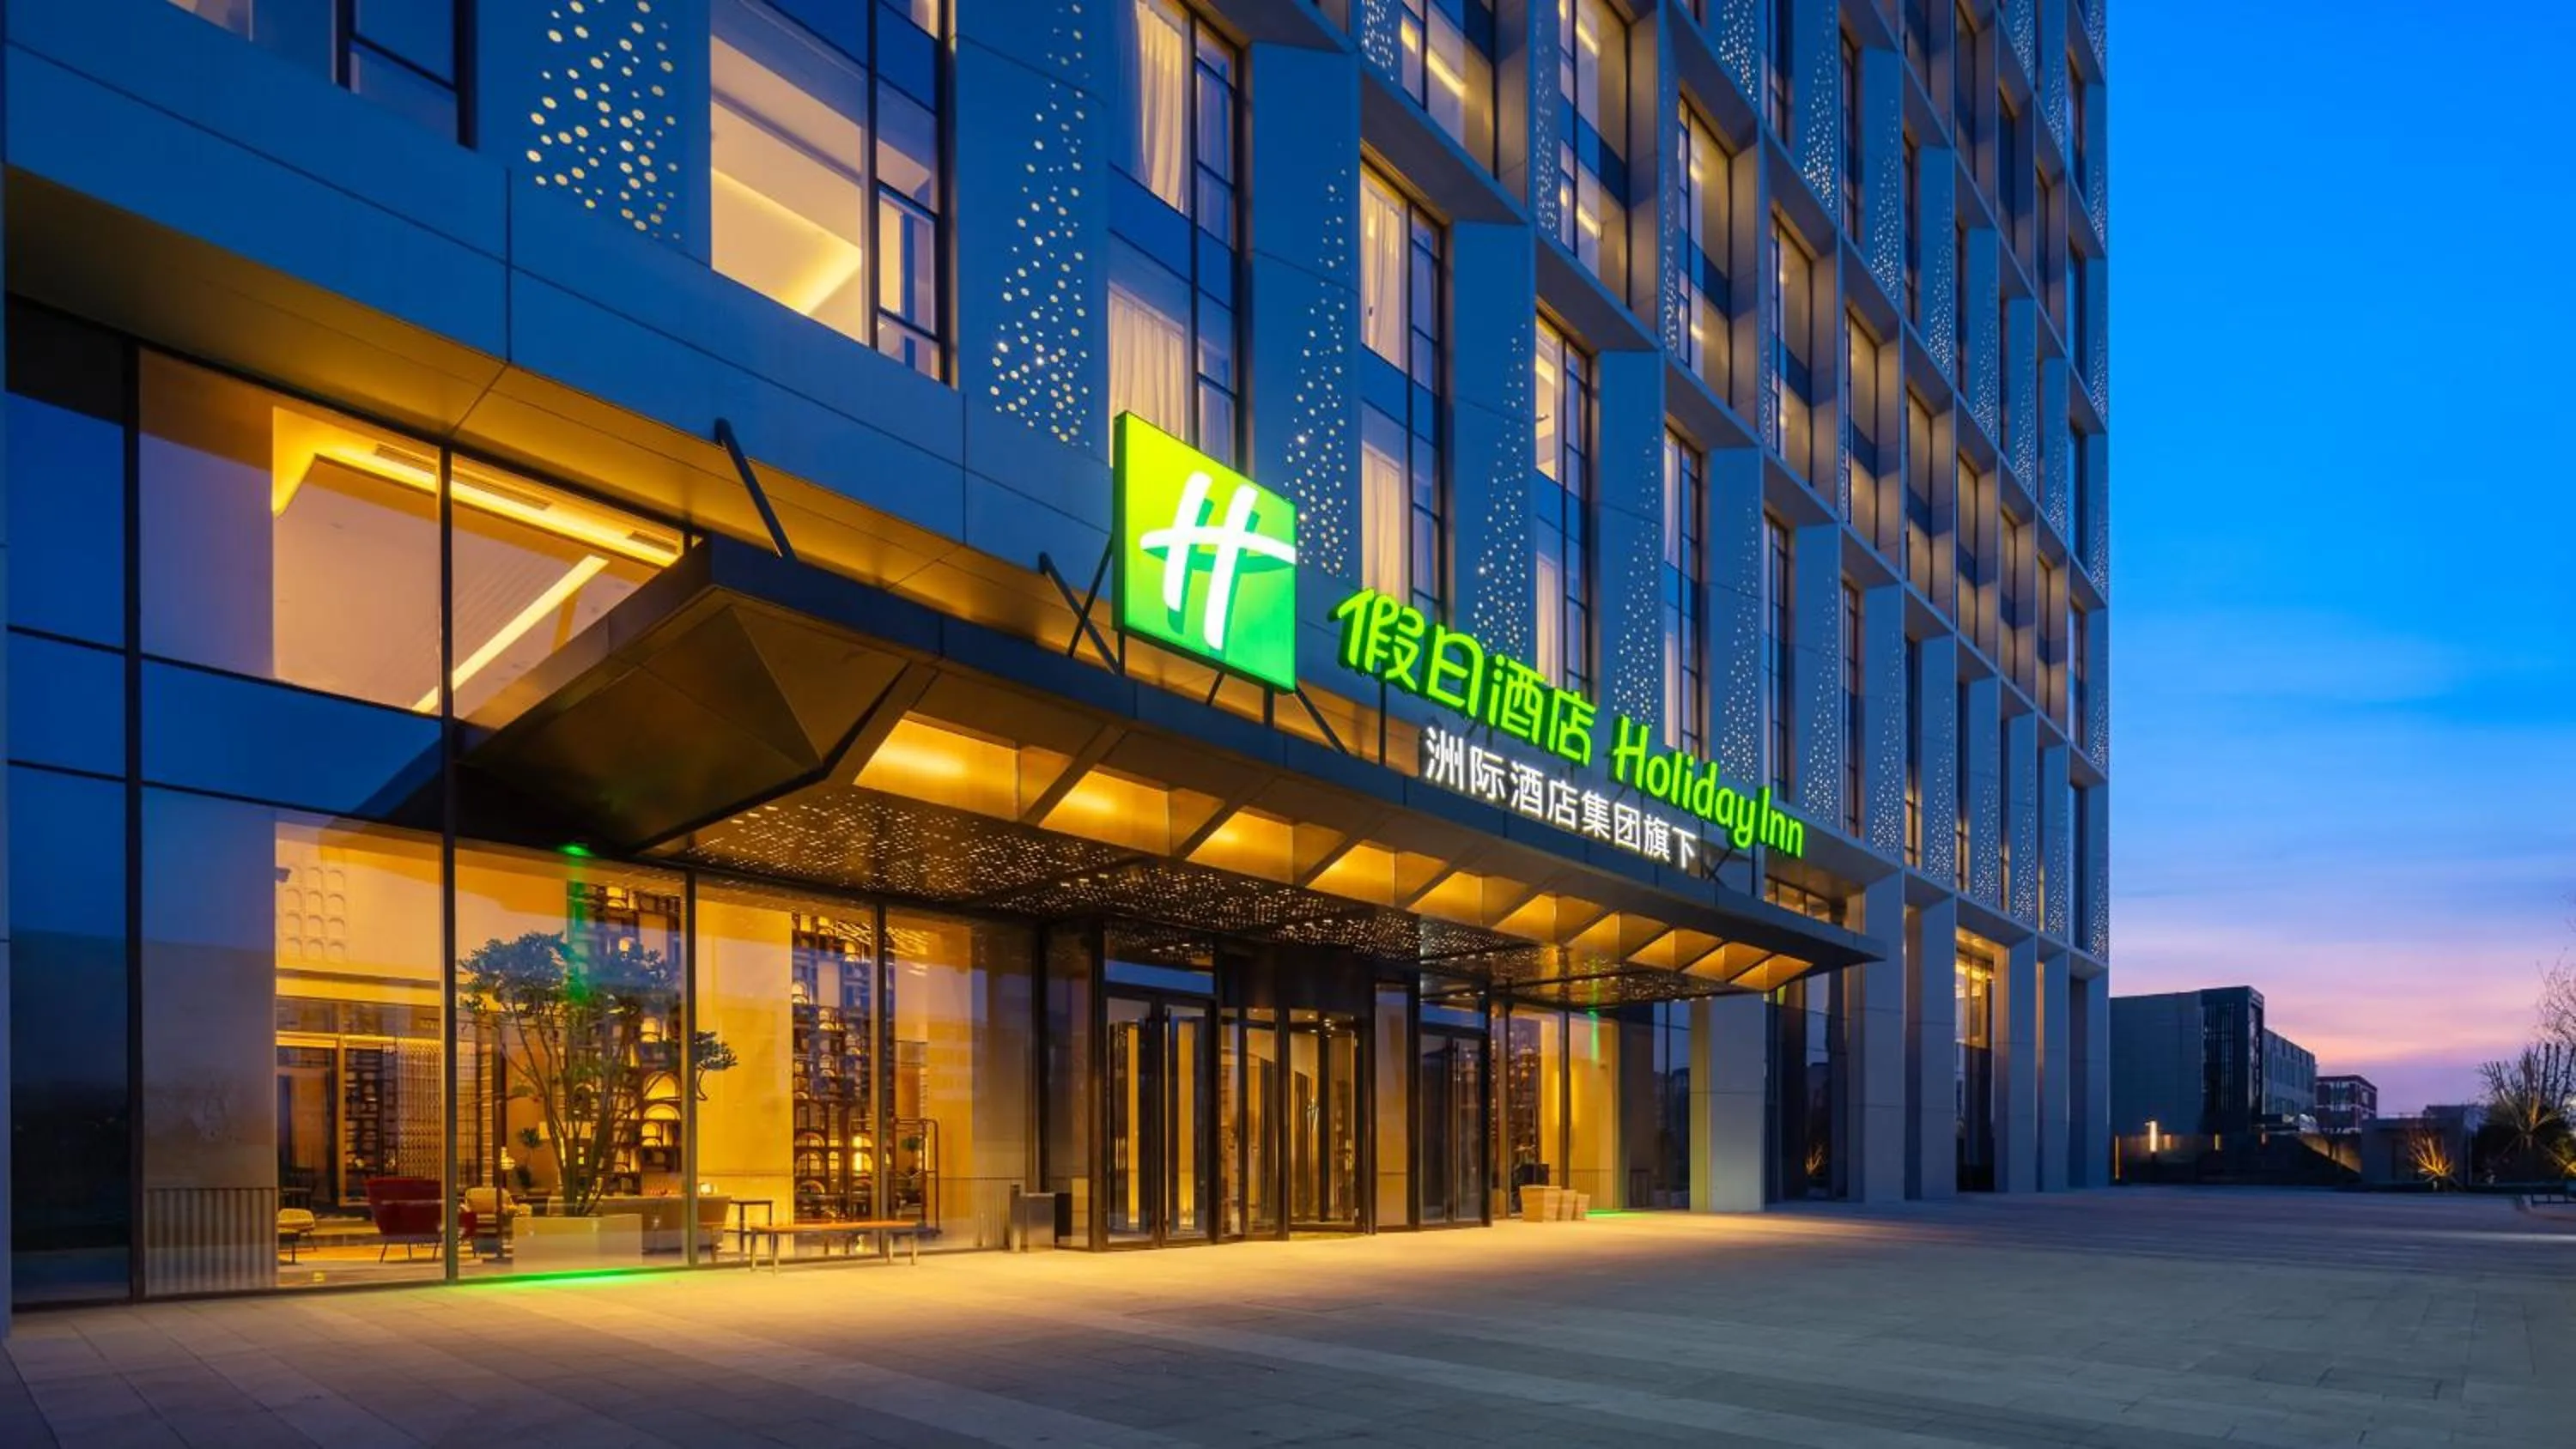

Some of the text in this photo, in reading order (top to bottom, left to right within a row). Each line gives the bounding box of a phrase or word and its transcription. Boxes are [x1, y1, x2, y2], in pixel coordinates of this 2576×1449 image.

[1334, 587, 1597, 767] 假日酒店
[1425, 726, 1698, 870] 洲际酒店集团旗下
[1611, 713, 1806, 858] Holiday Inn
